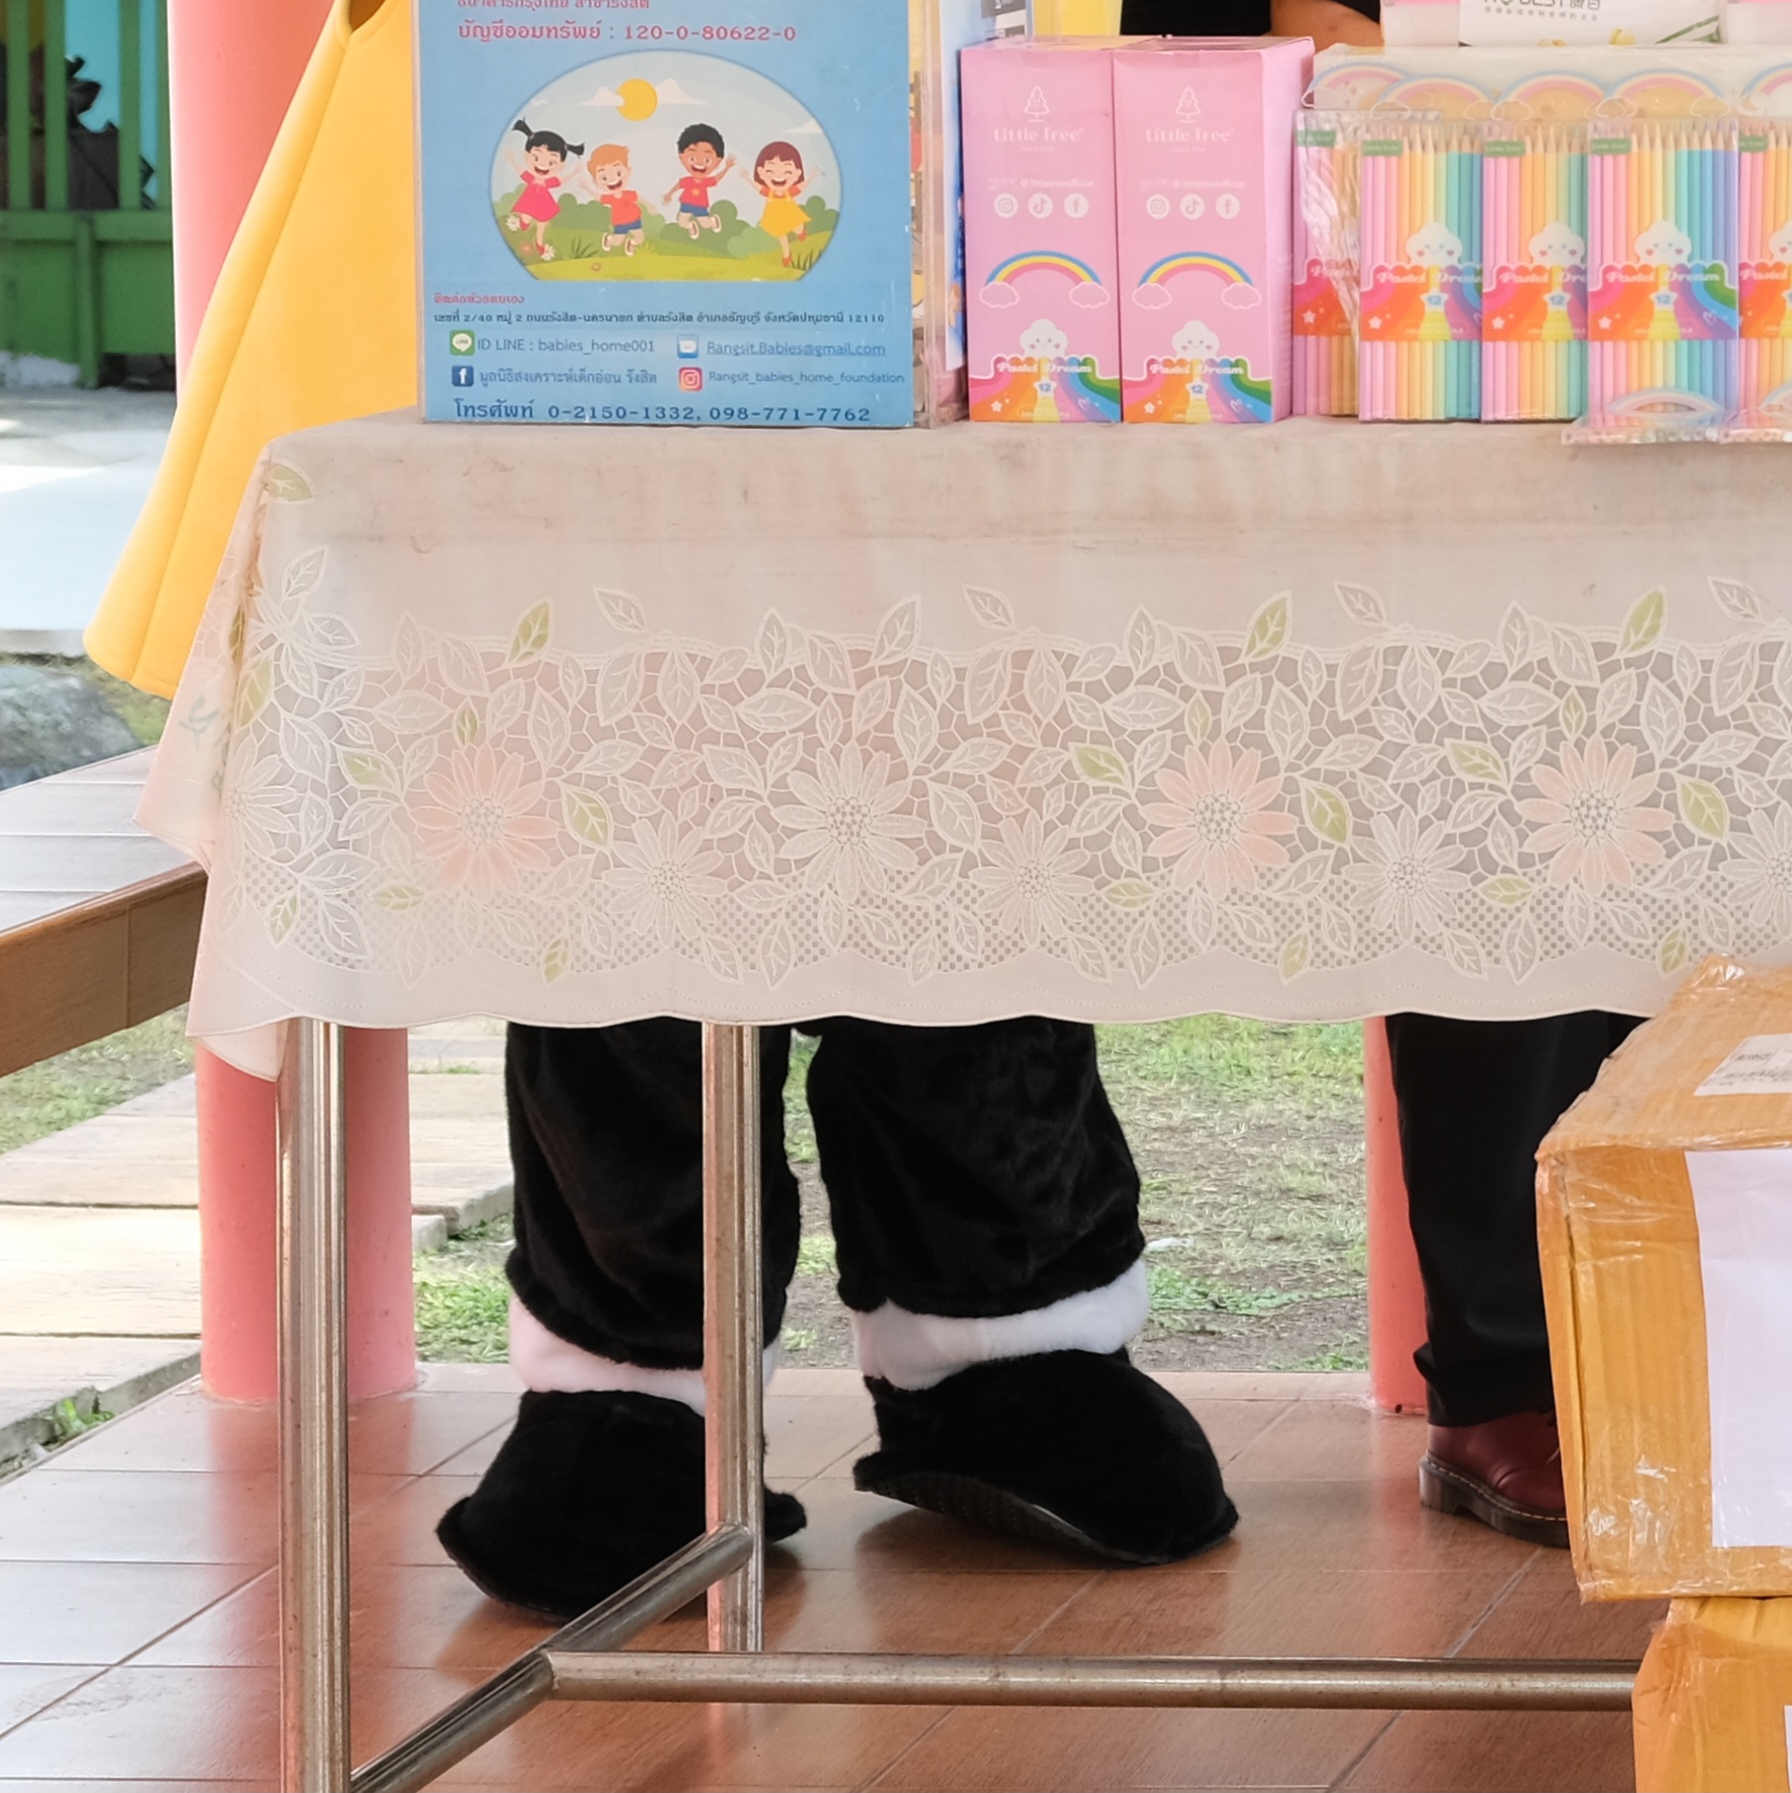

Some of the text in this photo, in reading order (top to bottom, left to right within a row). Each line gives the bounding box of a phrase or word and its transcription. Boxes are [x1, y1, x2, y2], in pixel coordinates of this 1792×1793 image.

[624, 24, 796, 41] 120-0-80622-0
[994, 127, 1038, 142] Little
[1146, 128, 1190, 143] Little
[463, 314, 492, 322] 2/40
[848, 314, 884, 322] 12110
[478, 339, 492, 352] ID
[495, 339, 526, 352] LINE
[538, 338, 654, 354] babies_home001
[454, 398, 535, 419] โทรศัพท์
[709, 408, 871, 421] 098-771-7762
